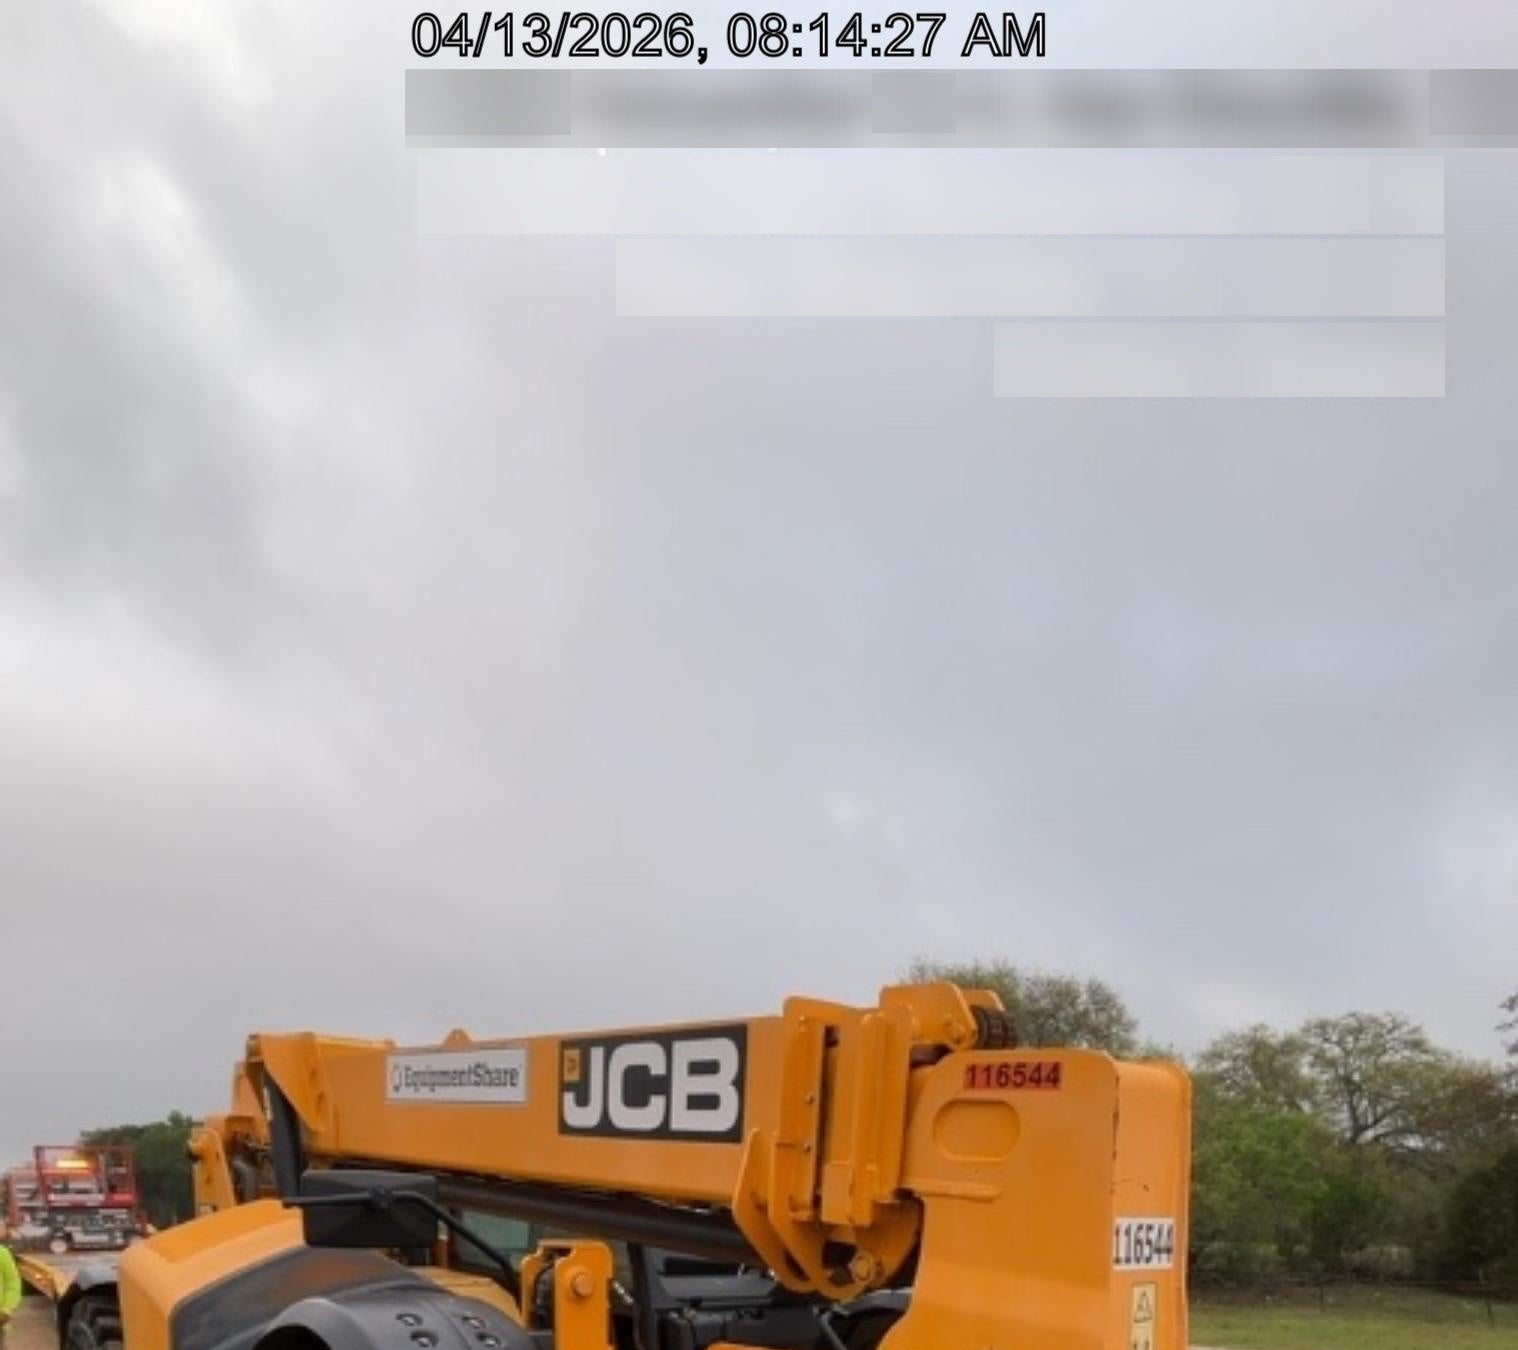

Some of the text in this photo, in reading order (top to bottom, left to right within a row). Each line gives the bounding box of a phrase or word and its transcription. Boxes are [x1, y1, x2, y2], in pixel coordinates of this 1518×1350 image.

[403, 1062, 519, 1093] EquipmentShare
[562, 1037, 740, 1132] JCB
[968, 1062, 1061, 1089] 116544
[1113, 1223, 1173, 1264] 116544
